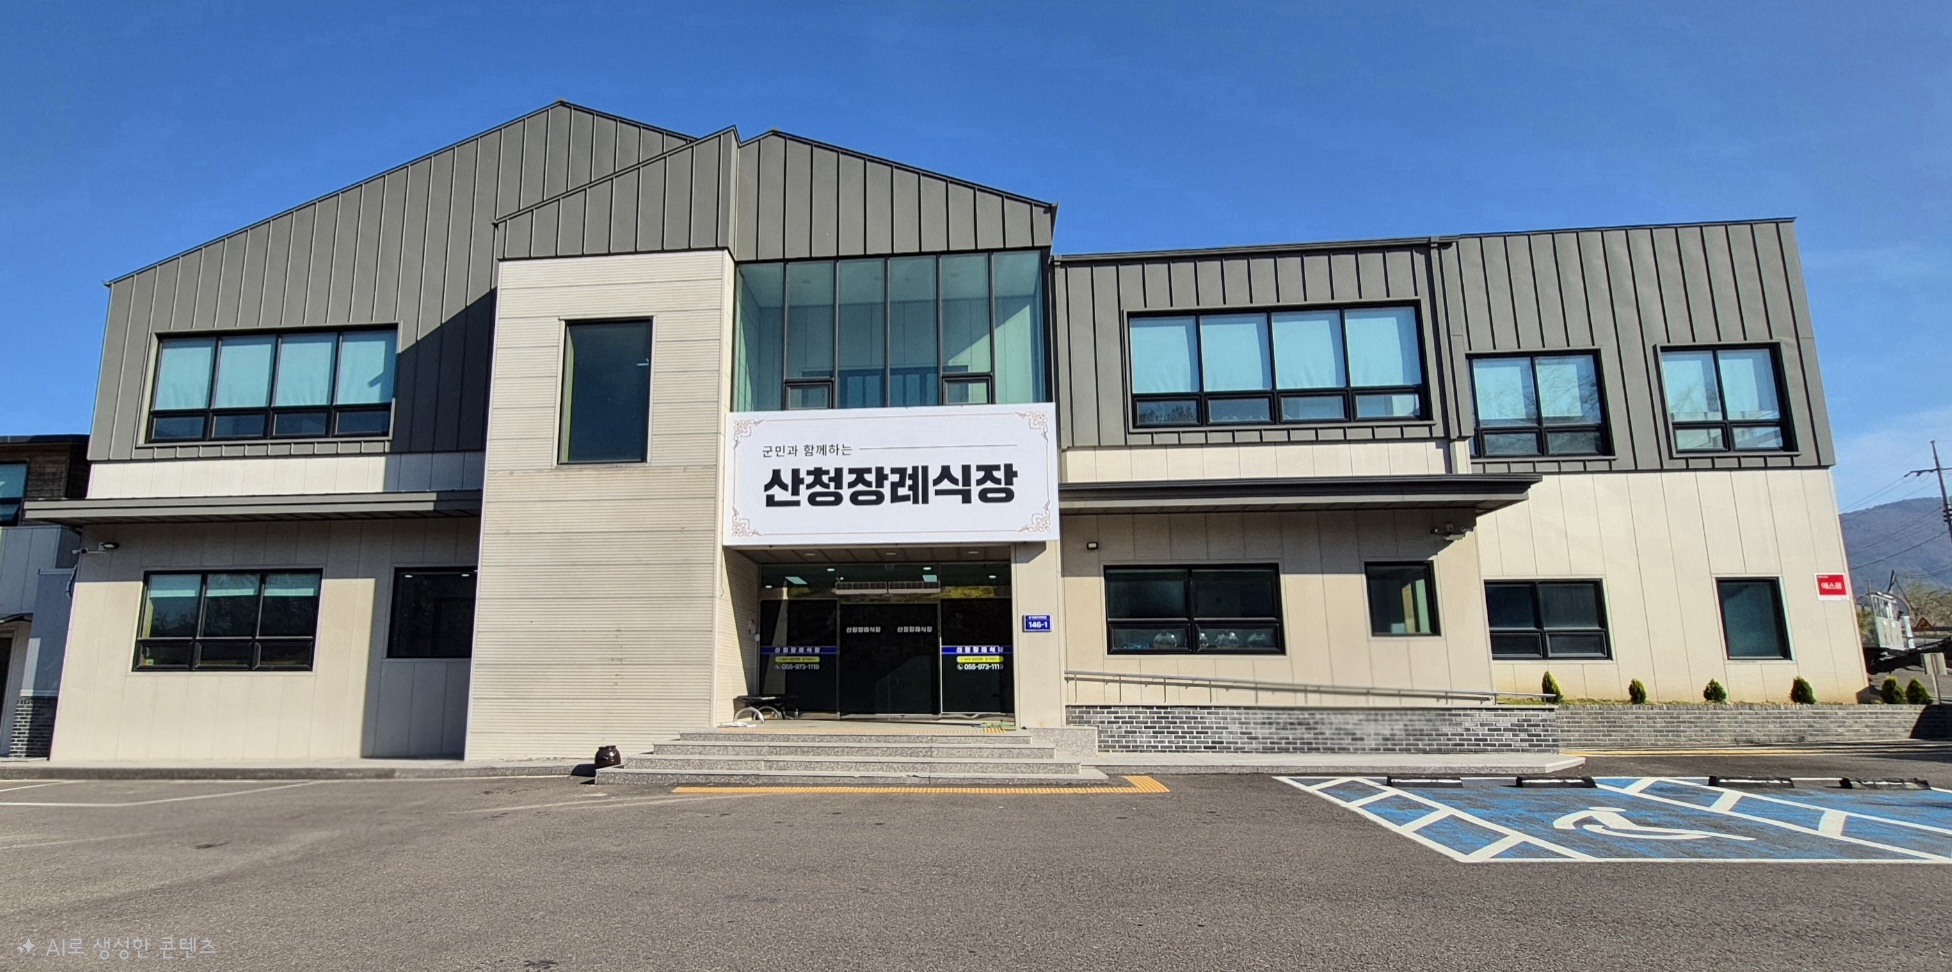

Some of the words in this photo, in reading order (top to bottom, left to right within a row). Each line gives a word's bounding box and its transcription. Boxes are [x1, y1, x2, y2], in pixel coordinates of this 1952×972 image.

[762, 445, 799, 458] 군민과
[803, 443, 853, 457] 함께하는
[763, 463, 1018, 507] 산청장례식장
